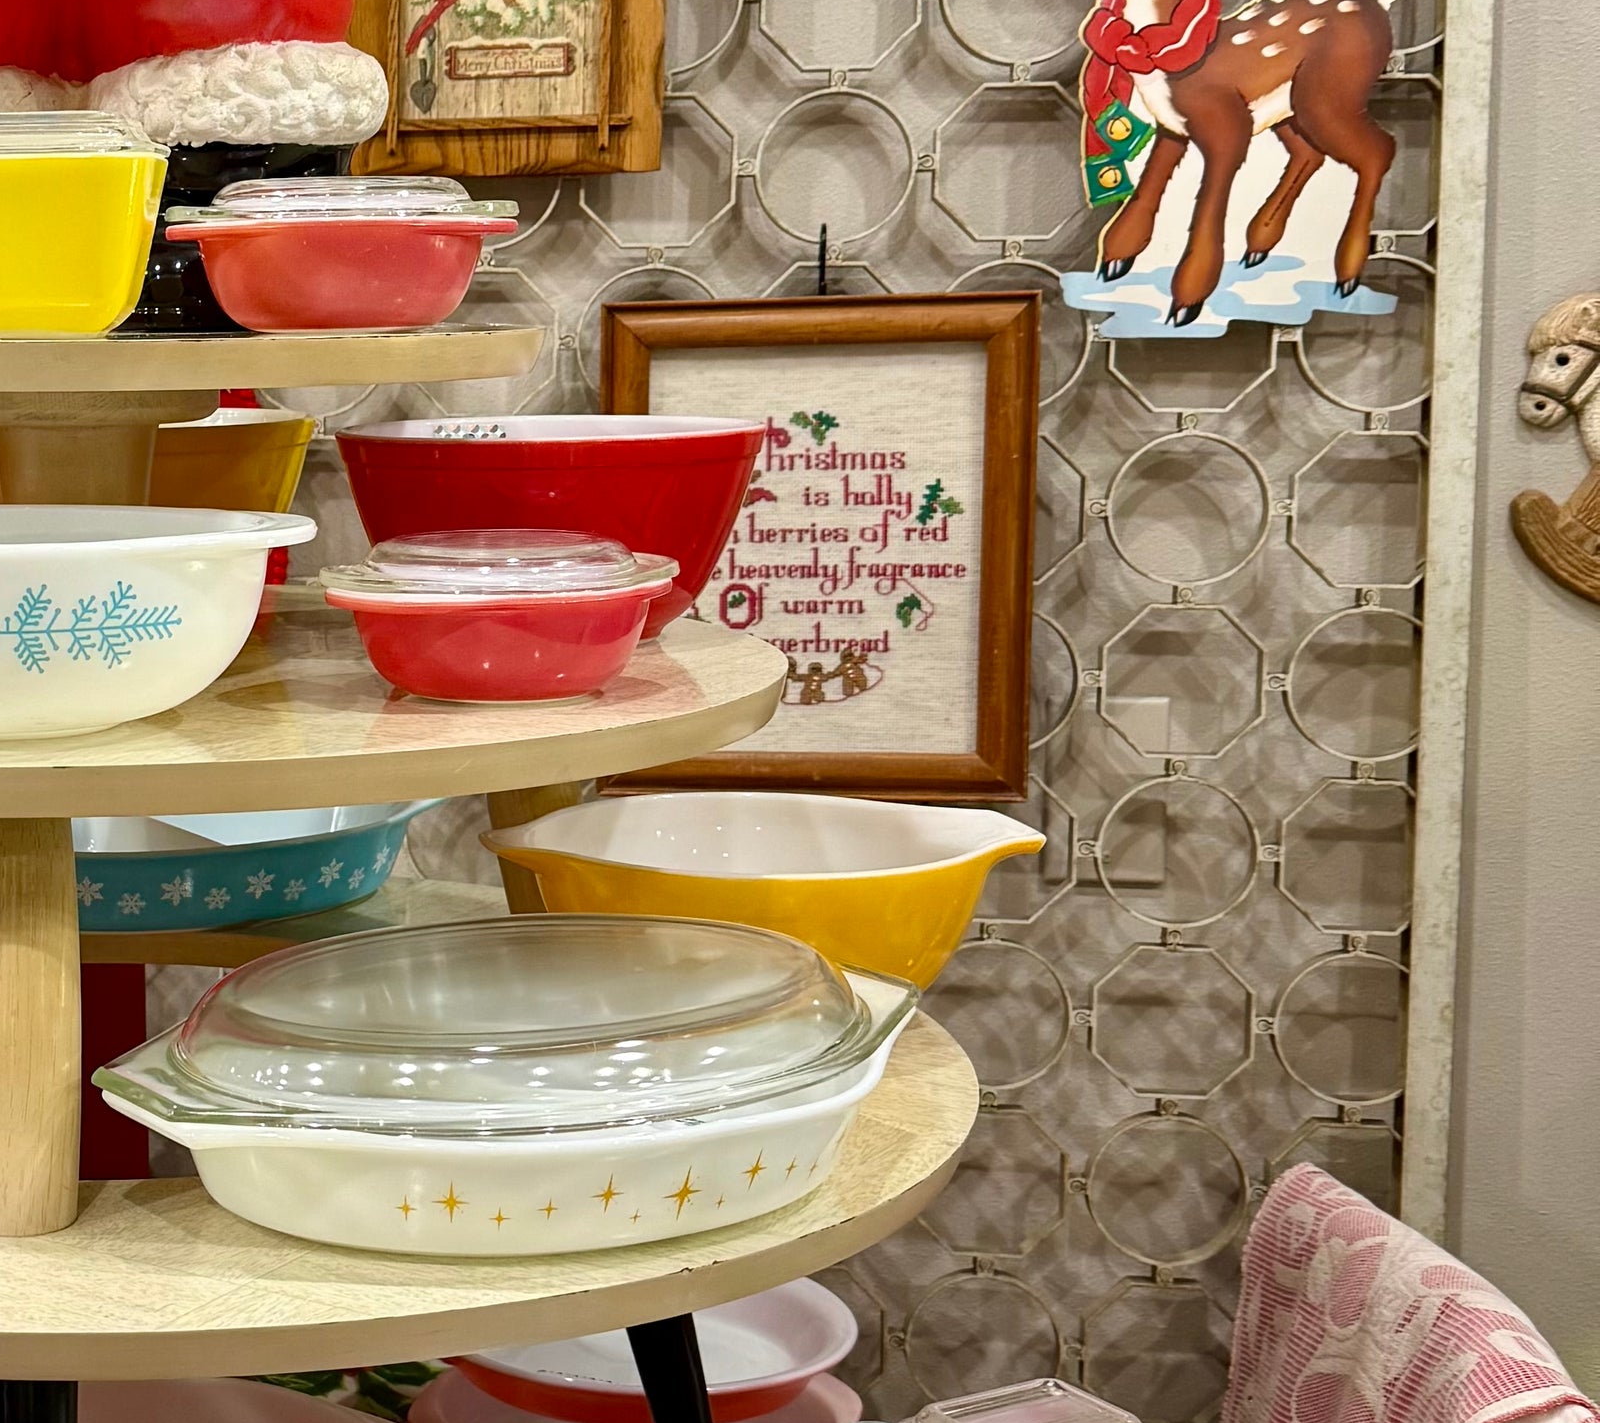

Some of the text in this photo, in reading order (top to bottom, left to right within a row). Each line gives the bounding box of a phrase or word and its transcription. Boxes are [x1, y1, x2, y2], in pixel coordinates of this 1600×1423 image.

[457, 58, 491, 73] Merry
[763, 416, 907, 472] hristmas
[802, 474, 913, 520] is holly
[746, 512, 849, 544] berries
[859, 509, 896, 553] of
[903, 516, 949, 543] red
[727, 546, 967, 596] heavenly fragrance
[780, 598, 865, 615] warm
[766, 621, 889, 653] gerbread
